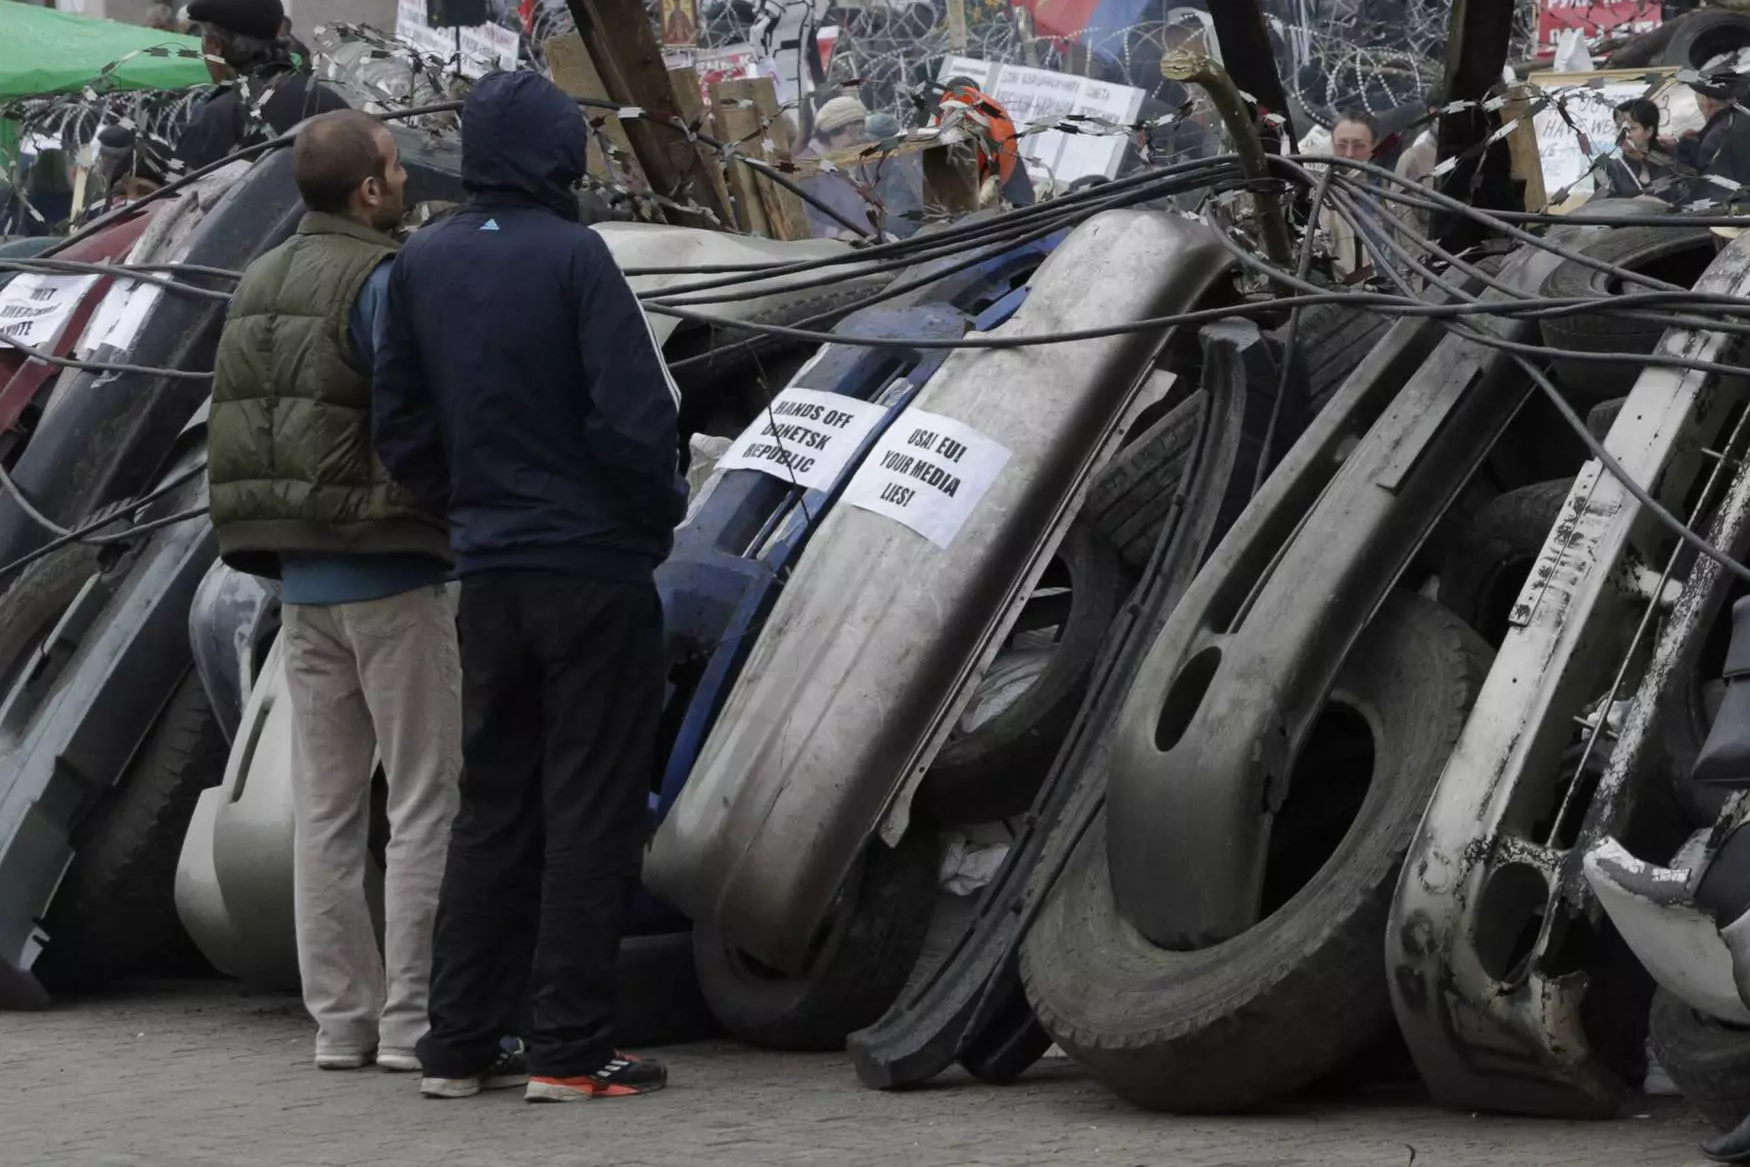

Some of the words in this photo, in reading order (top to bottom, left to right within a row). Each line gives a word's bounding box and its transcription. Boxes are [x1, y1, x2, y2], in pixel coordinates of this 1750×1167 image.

[774, 401, 823, 421] HANDS
[823, 407, 855, 430] OFF
[760, 423, 832, 451] DONETSK
[907, 428, 937, 450] USA!
[936, 437, 968, 464] EU!
[742, 442, 816, 473] REPUBLIC
[879, 449, 912, 474] YOUR
[910, 459, 962, 498] MEDIA
[879, 482, 916, 508] LIES!
